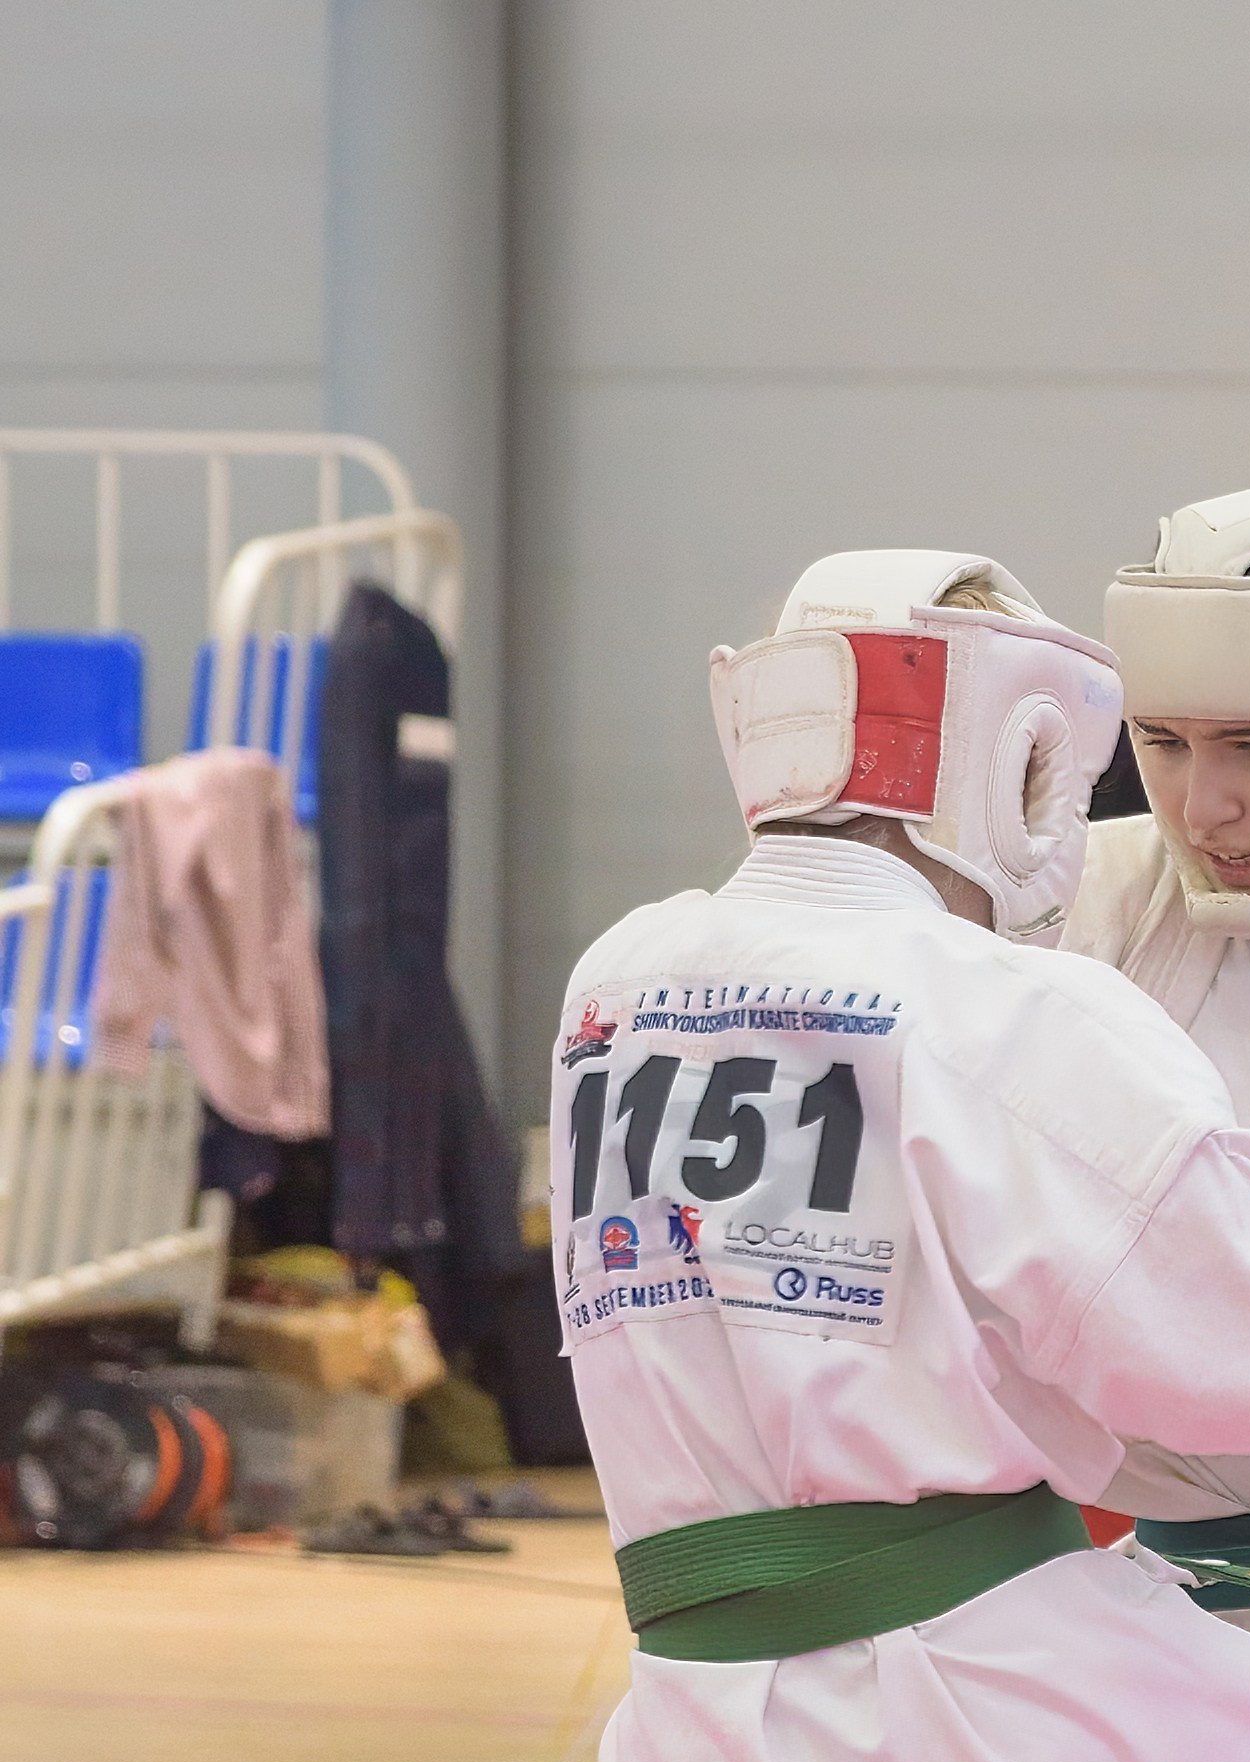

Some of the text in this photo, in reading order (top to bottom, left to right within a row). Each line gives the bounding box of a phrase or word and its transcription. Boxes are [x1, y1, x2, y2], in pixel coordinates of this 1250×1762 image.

[638, 986, 904, 1013] INTERNATIONAL
[570, 1055, 864, 1222] 1151
[723, 1221, 895, 1260] LOCALHUB
[815, 1276, 885, 1307] Russ
